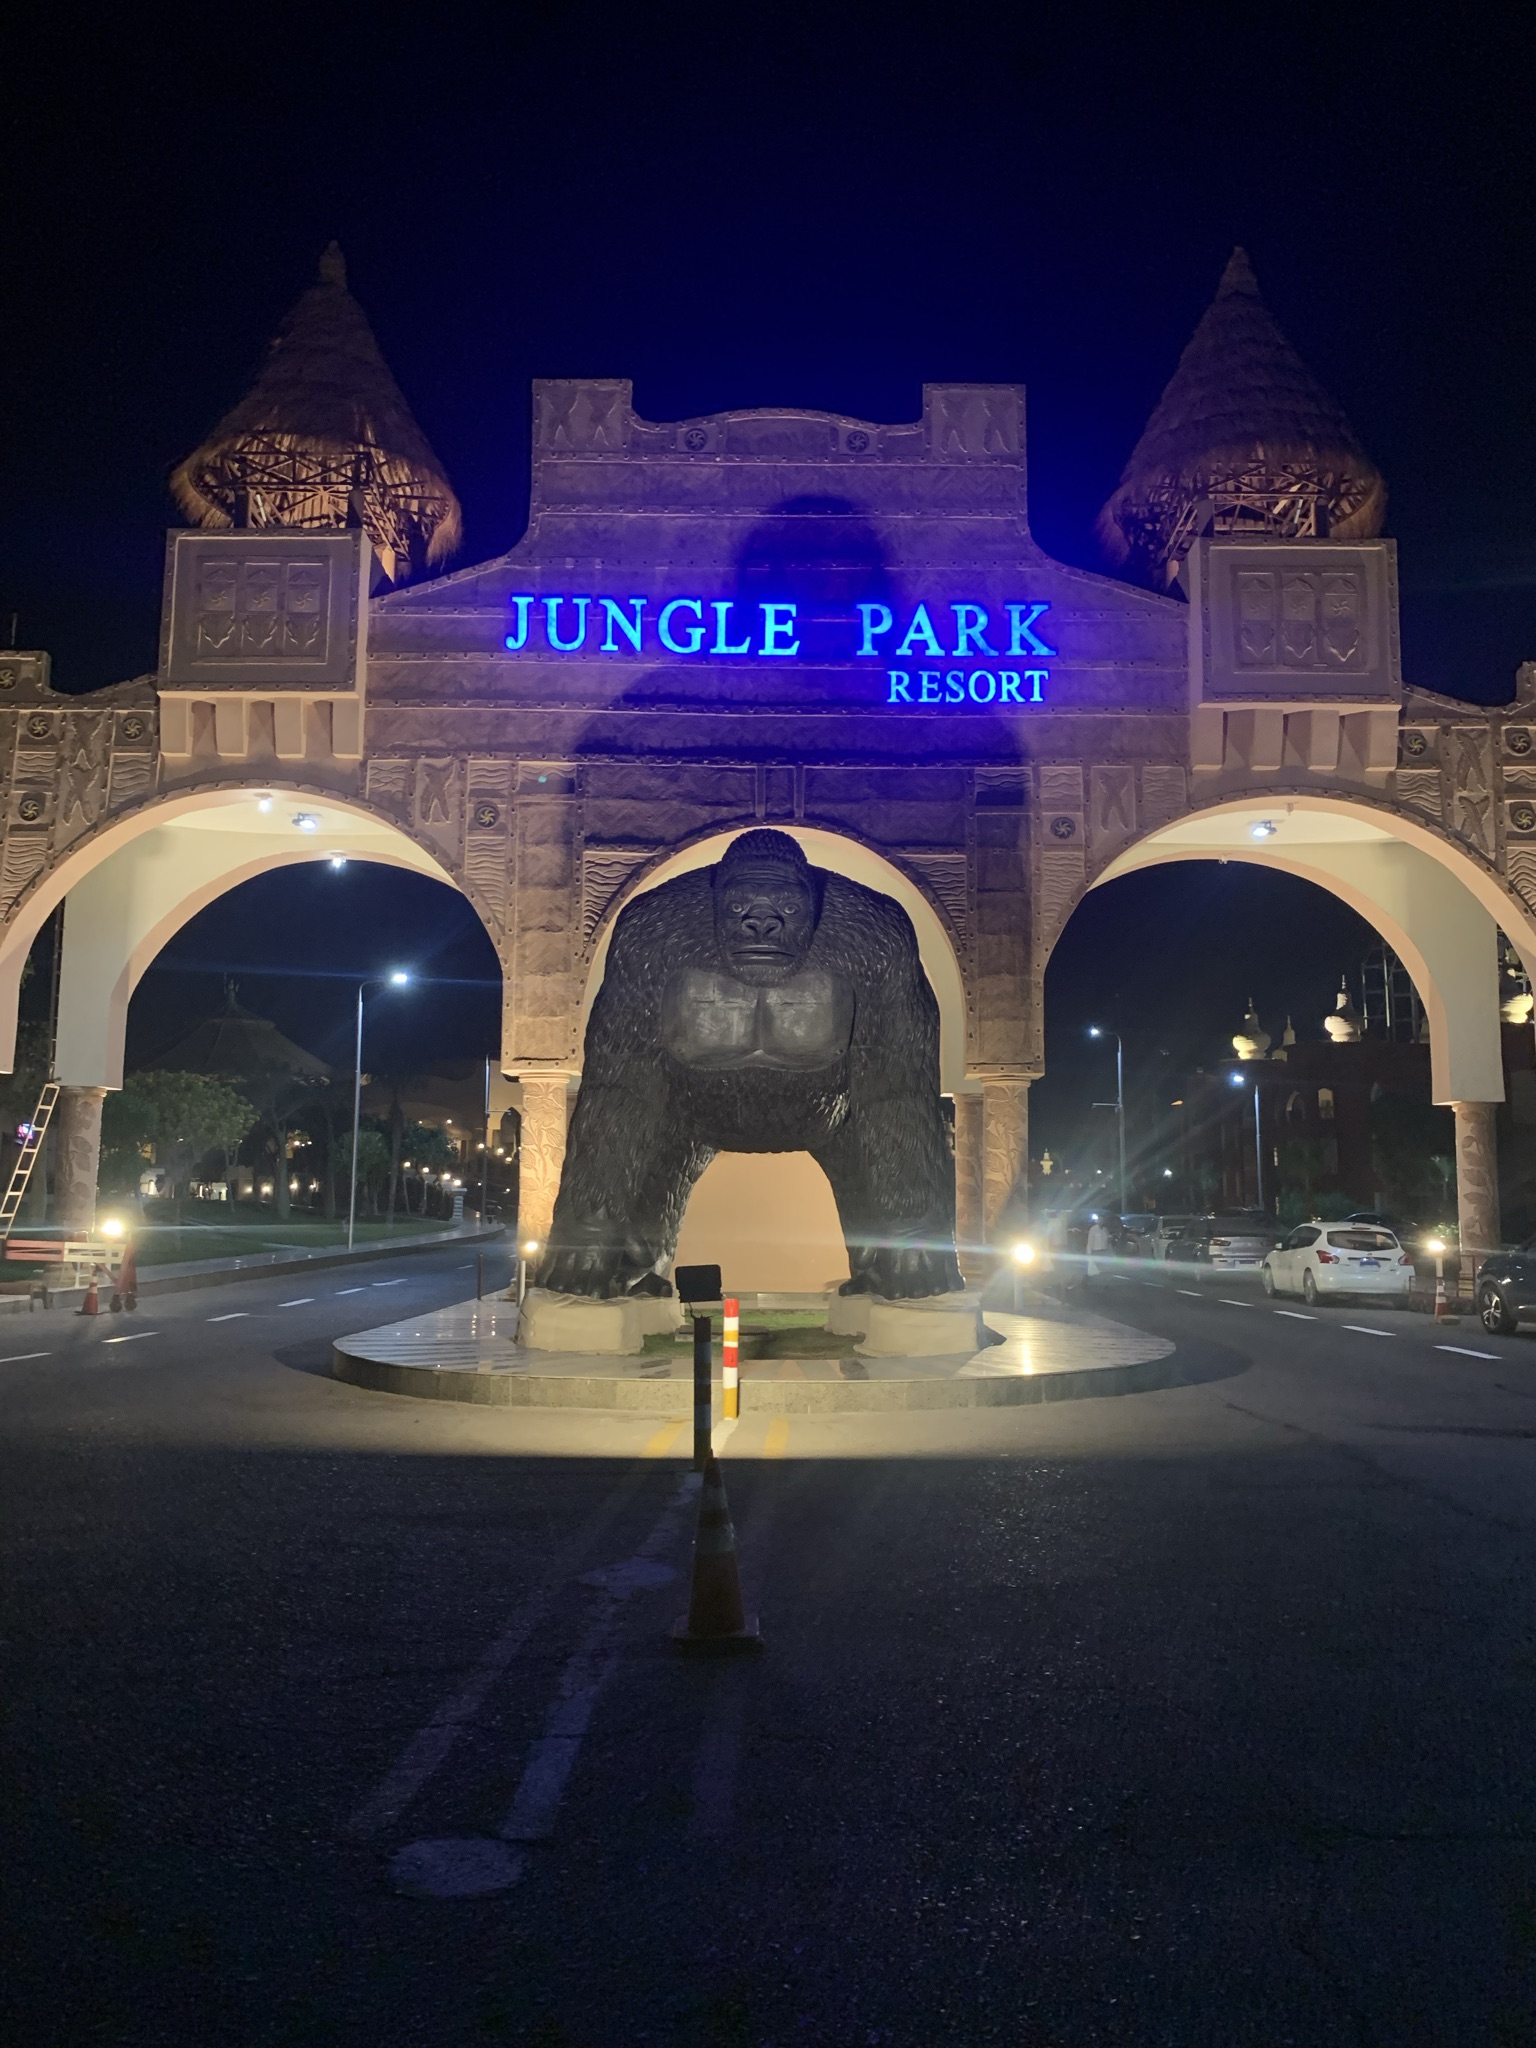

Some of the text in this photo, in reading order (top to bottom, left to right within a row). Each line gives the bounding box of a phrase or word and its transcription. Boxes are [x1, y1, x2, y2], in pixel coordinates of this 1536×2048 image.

[505, 596, 1057, 657] JUNGLE PARK
[887, 670, 1049, 703] RESORT
